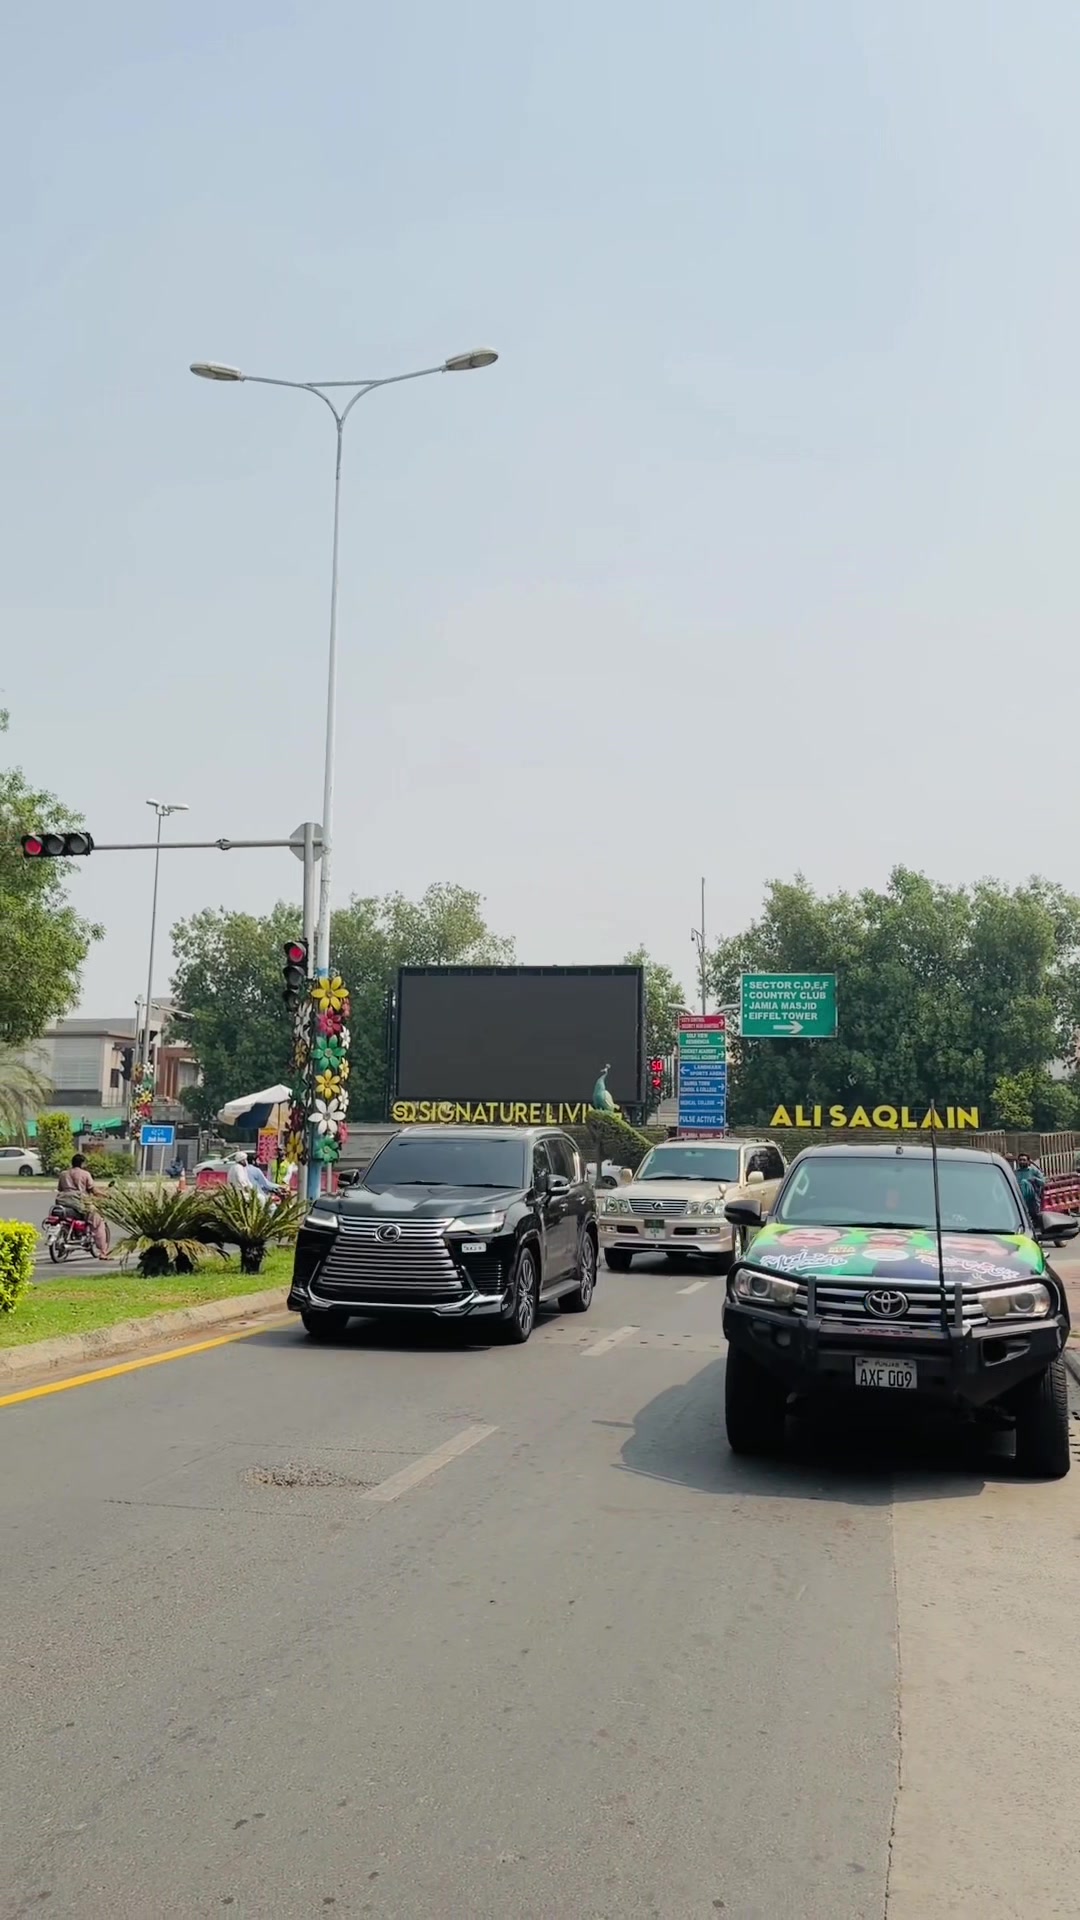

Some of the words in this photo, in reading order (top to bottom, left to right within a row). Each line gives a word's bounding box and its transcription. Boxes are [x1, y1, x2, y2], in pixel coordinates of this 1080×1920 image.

[749, 981, 792, 989] SECTOR
[793, 981, 829, 991] C,D,E,F
[749, 991, 797, 999] COUNTRY
[800, 992, 826, 1000] CLUB
[749, 1002, 778, 1010] JAMIA
[781, 1002, 817, 1010] MASJID
[748, 1012, 780, 1020] EIFFEL
[781, 1012, 818, 1020] TOWER
[418, 1101, 542, 1124] SIGNATURE
[769, 1104, 822, 1127] ALI
[829, 1105, 979, 1130] SAQLAIN
[860, 1368, 885, 1387] AXF
[888, 1370, 912, 1388] 009
